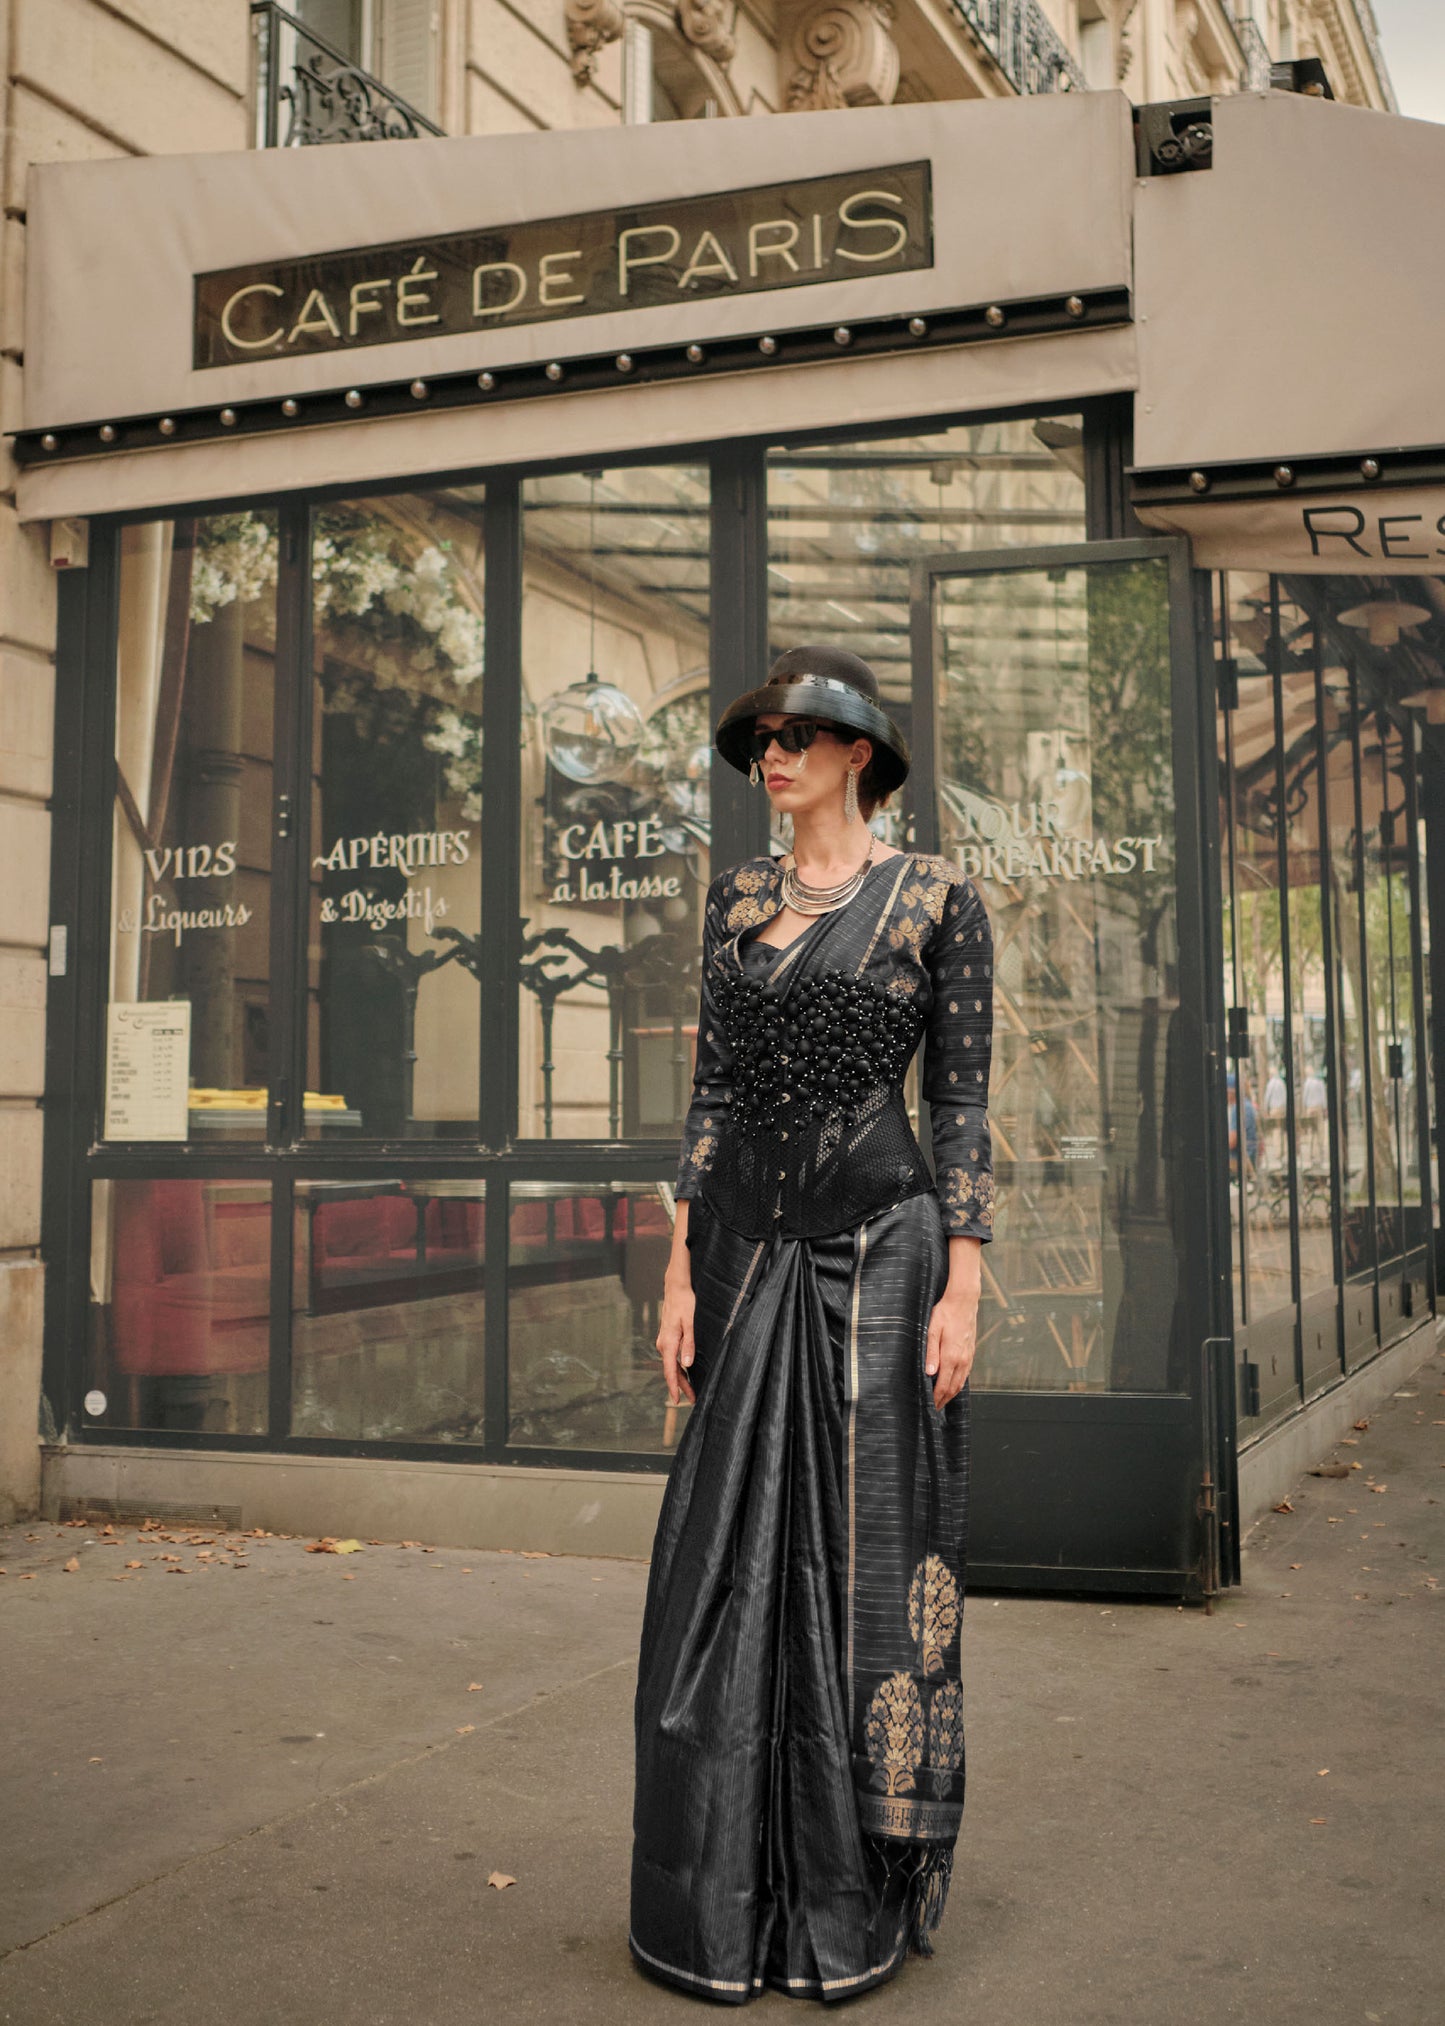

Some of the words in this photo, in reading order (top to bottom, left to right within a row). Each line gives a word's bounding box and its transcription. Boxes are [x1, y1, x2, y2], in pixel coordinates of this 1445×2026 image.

[221, 256, 441, 349] CAFÉ
[473, 250, 585, 317] DE
[619, 190, 907, 295] PARIS
[1303, 506, 1445, 559] RE
[312, 831, 470, 878] APÉRITIFS
[559, 813, 667, 860] CAFÉ
[952, 833, 1163, 885] BREAKFAST
[144, 841, 237, 882] VINS
[579, 866, 610, 901] la
[609, 865, 681, 900] tasse
[142, 894, 252, 947] Liqueurs
[319, 898, 339, 923] &
[340, 886, 450, 935] Digestifs
